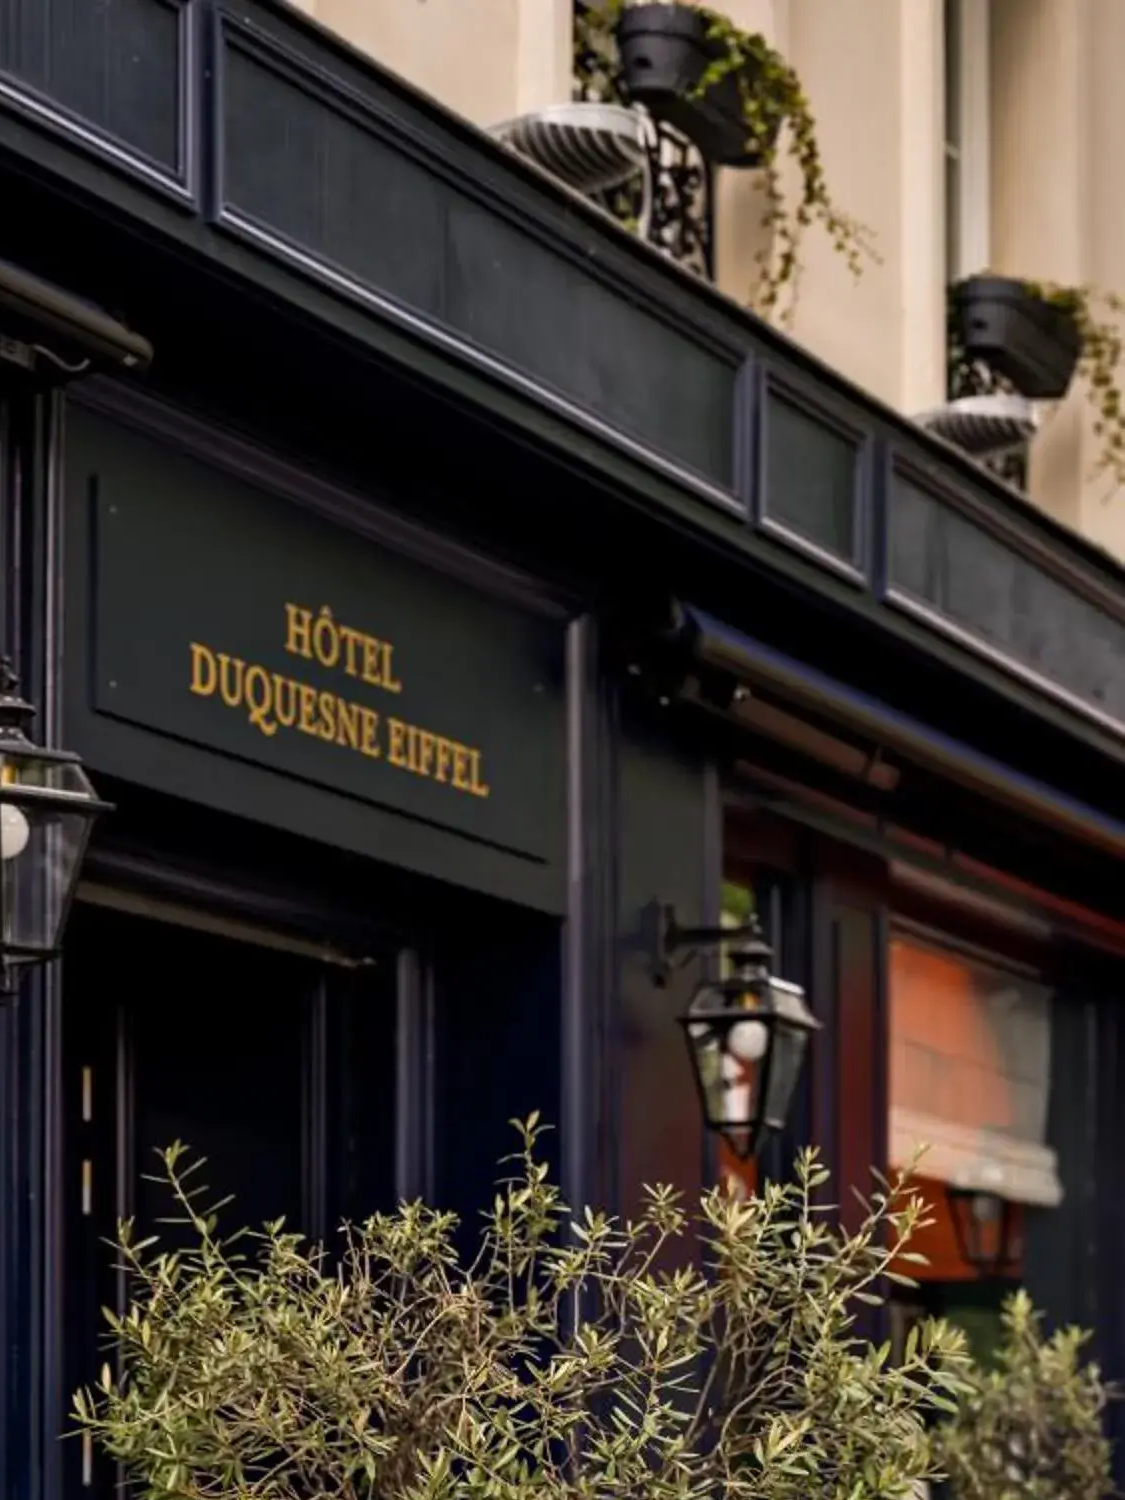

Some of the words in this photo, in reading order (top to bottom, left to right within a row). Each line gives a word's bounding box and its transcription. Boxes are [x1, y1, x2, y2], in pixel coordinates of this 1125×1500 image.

[285, 603, 402, 693] HÔTEL
[189, 642, 380, 757] DUQUESNE
[387, 717, 489, 797] EIFFEL
